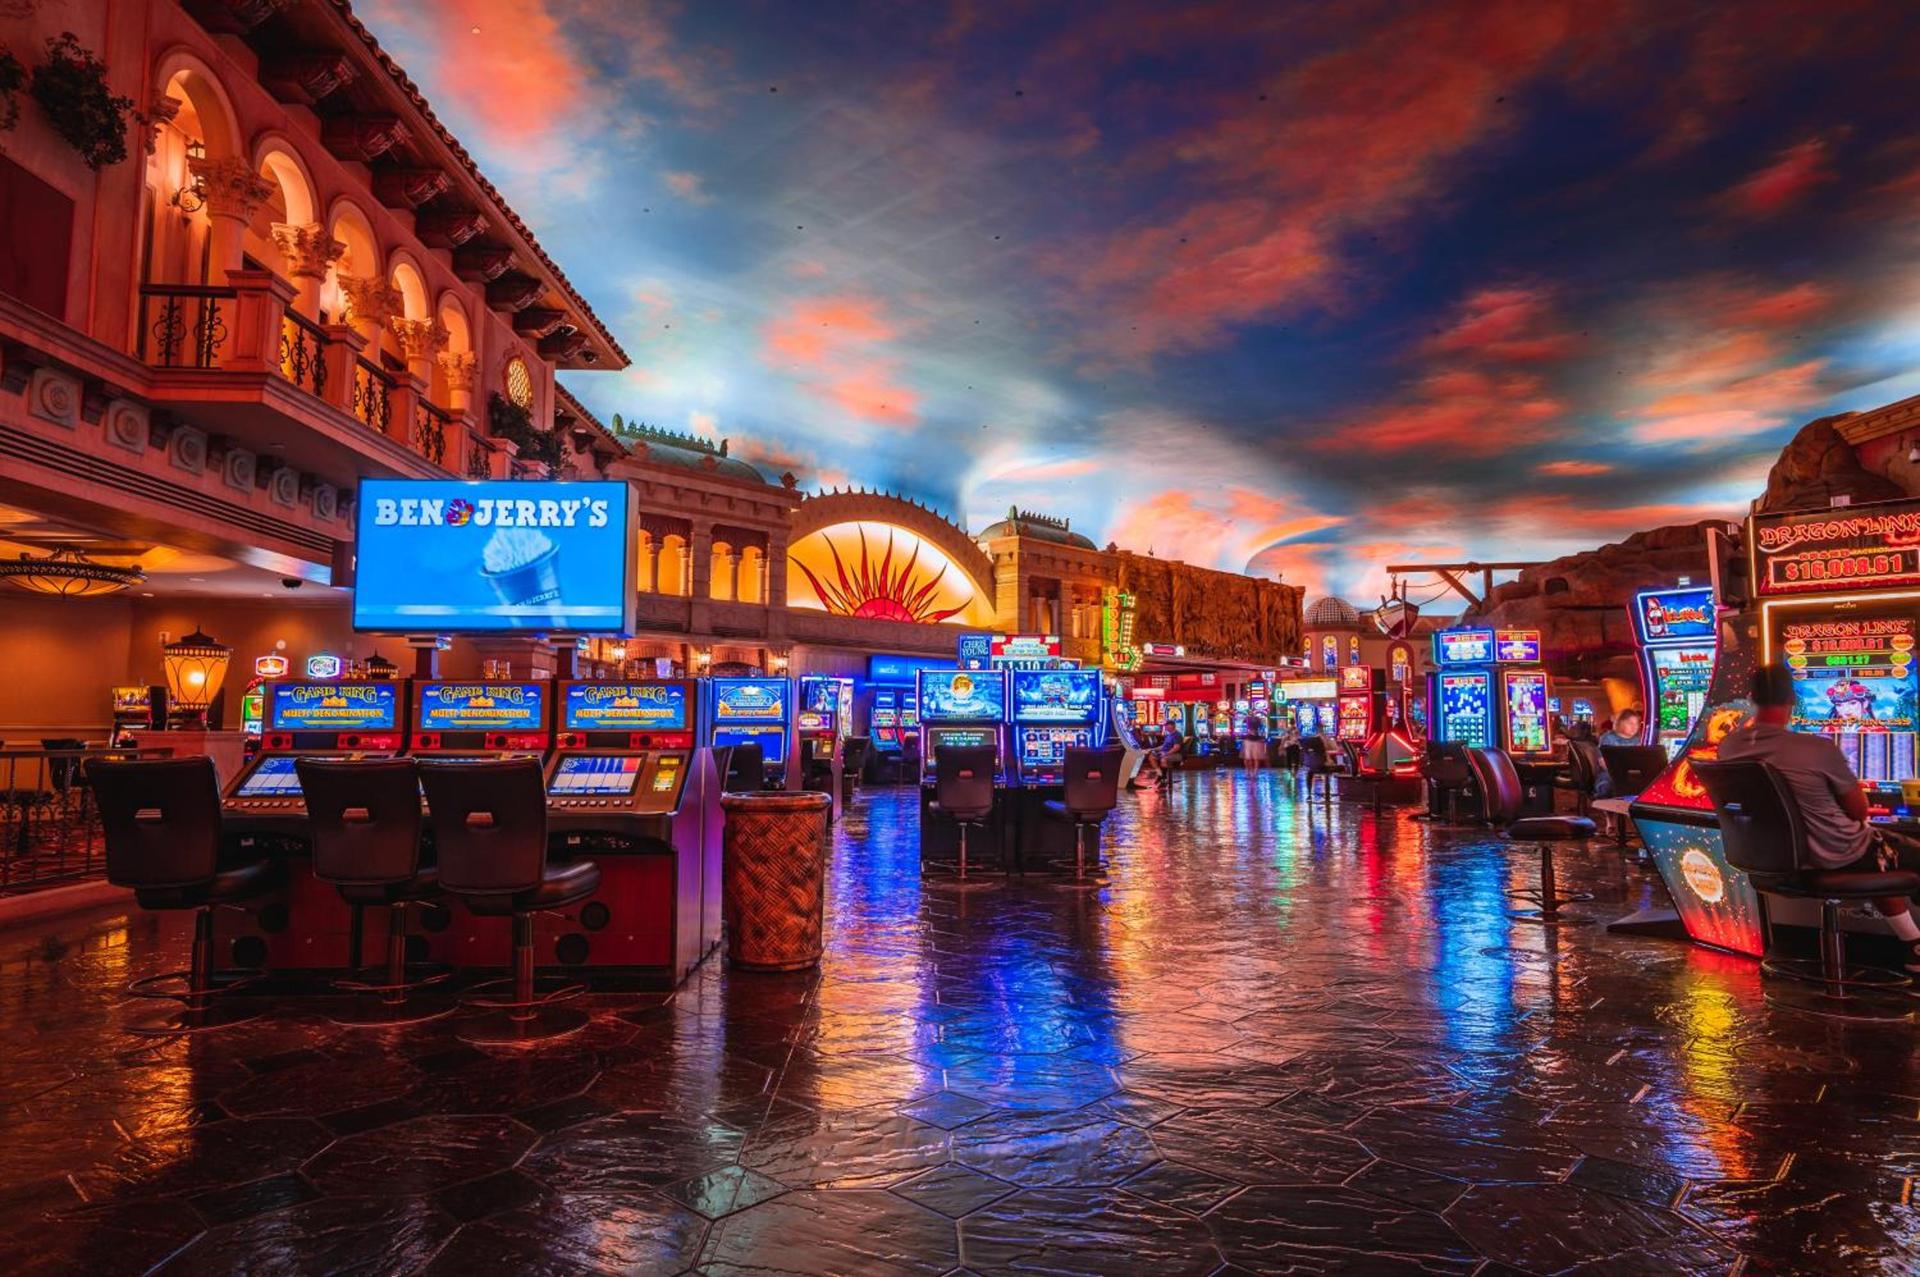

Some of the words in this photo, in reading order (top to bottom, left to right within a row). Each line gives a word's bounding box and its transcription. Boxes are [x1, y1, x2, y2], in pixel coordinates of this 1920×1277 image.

[374, 498, 444, 526] BEN
[474, 496, 609, 528] JERRY'S
[1759, 518, 1861, 546] DRAGON
[1798, 549, 1851, 561] GRAND
[1785, 622, 1861, 638] DRAGON
[1864, 619, 1909, 635] LINK
[962, 647, 989, 656] YOUNG
[291, 687, 337, 704] GAME
[339, 687, 378, 704] KING
[439, 687, 484, 704] GAME
[486, 687, 525, 704] KING
[584, 687, 628, 704] GAME
[631, 687, 668, 704] KING
